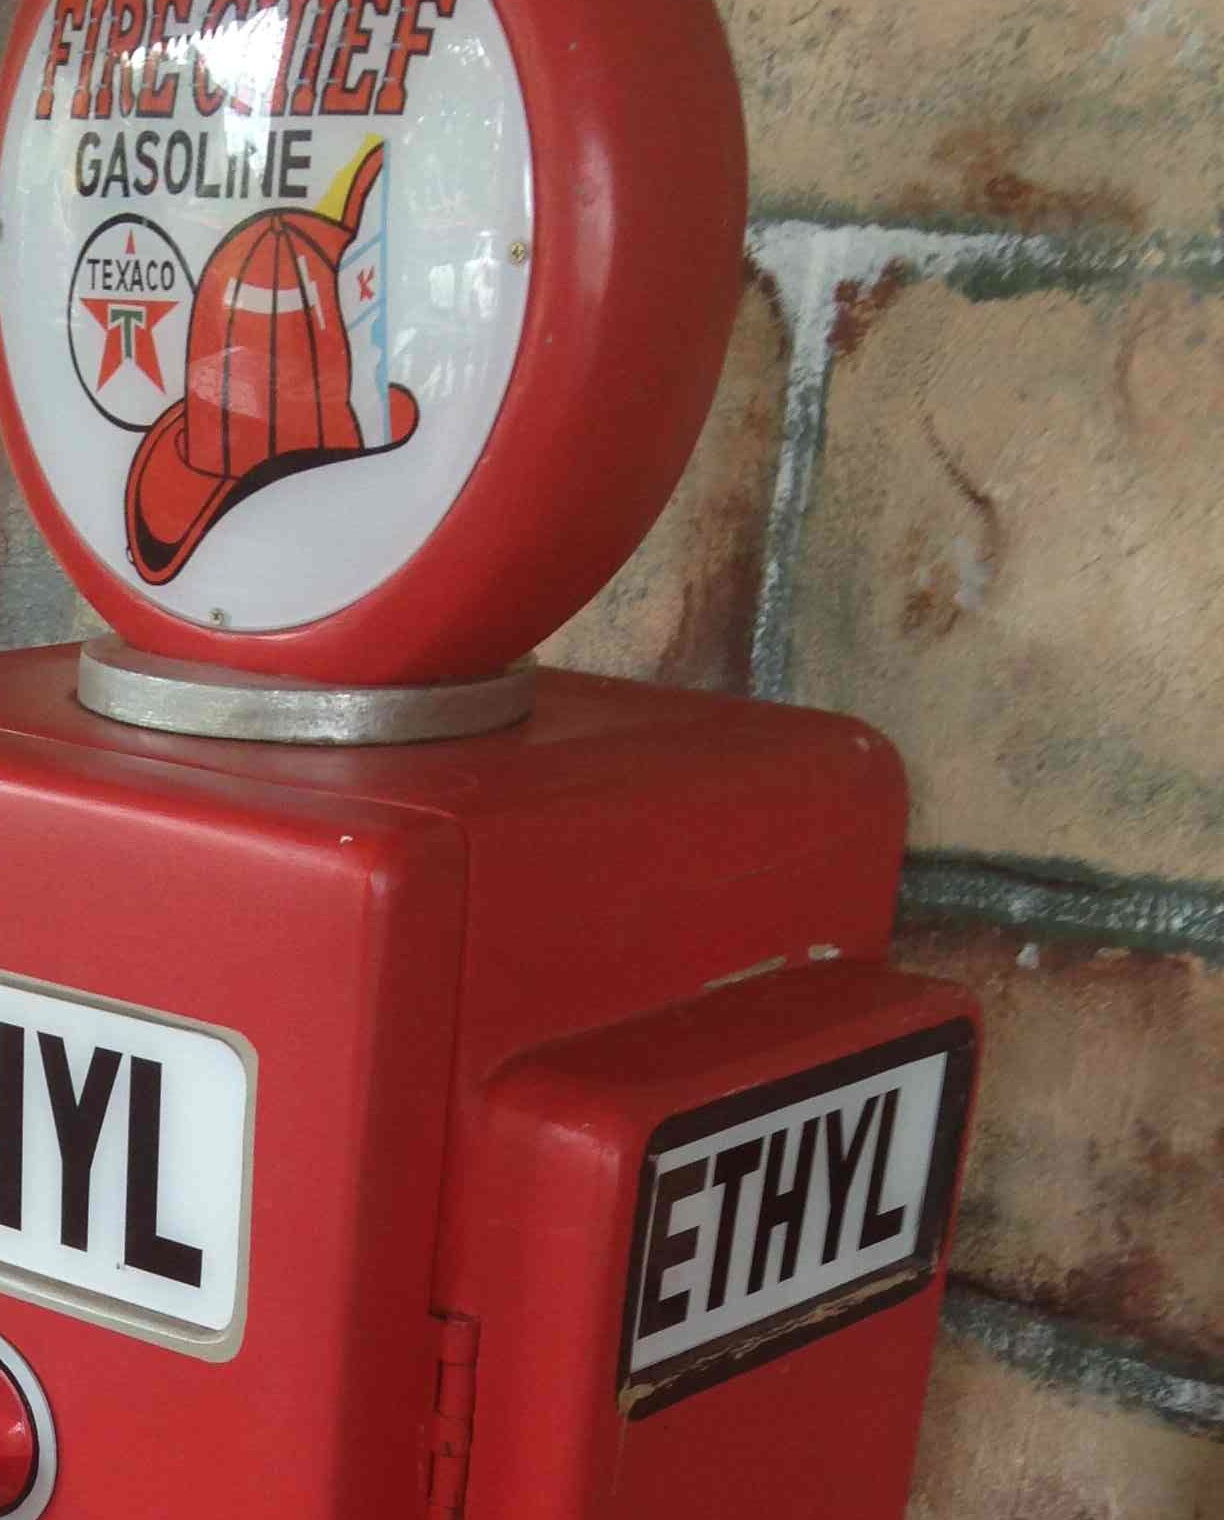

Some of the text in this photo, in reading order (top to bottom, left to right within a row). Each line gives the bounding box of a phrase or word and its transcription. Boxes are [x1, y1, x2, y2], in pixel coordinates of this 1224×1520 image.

[76, 129, 313, 200] GASOLINE
[86, 257, 176, 293] TEXACO
[637, 1086, 908, 1341] ETHYL
